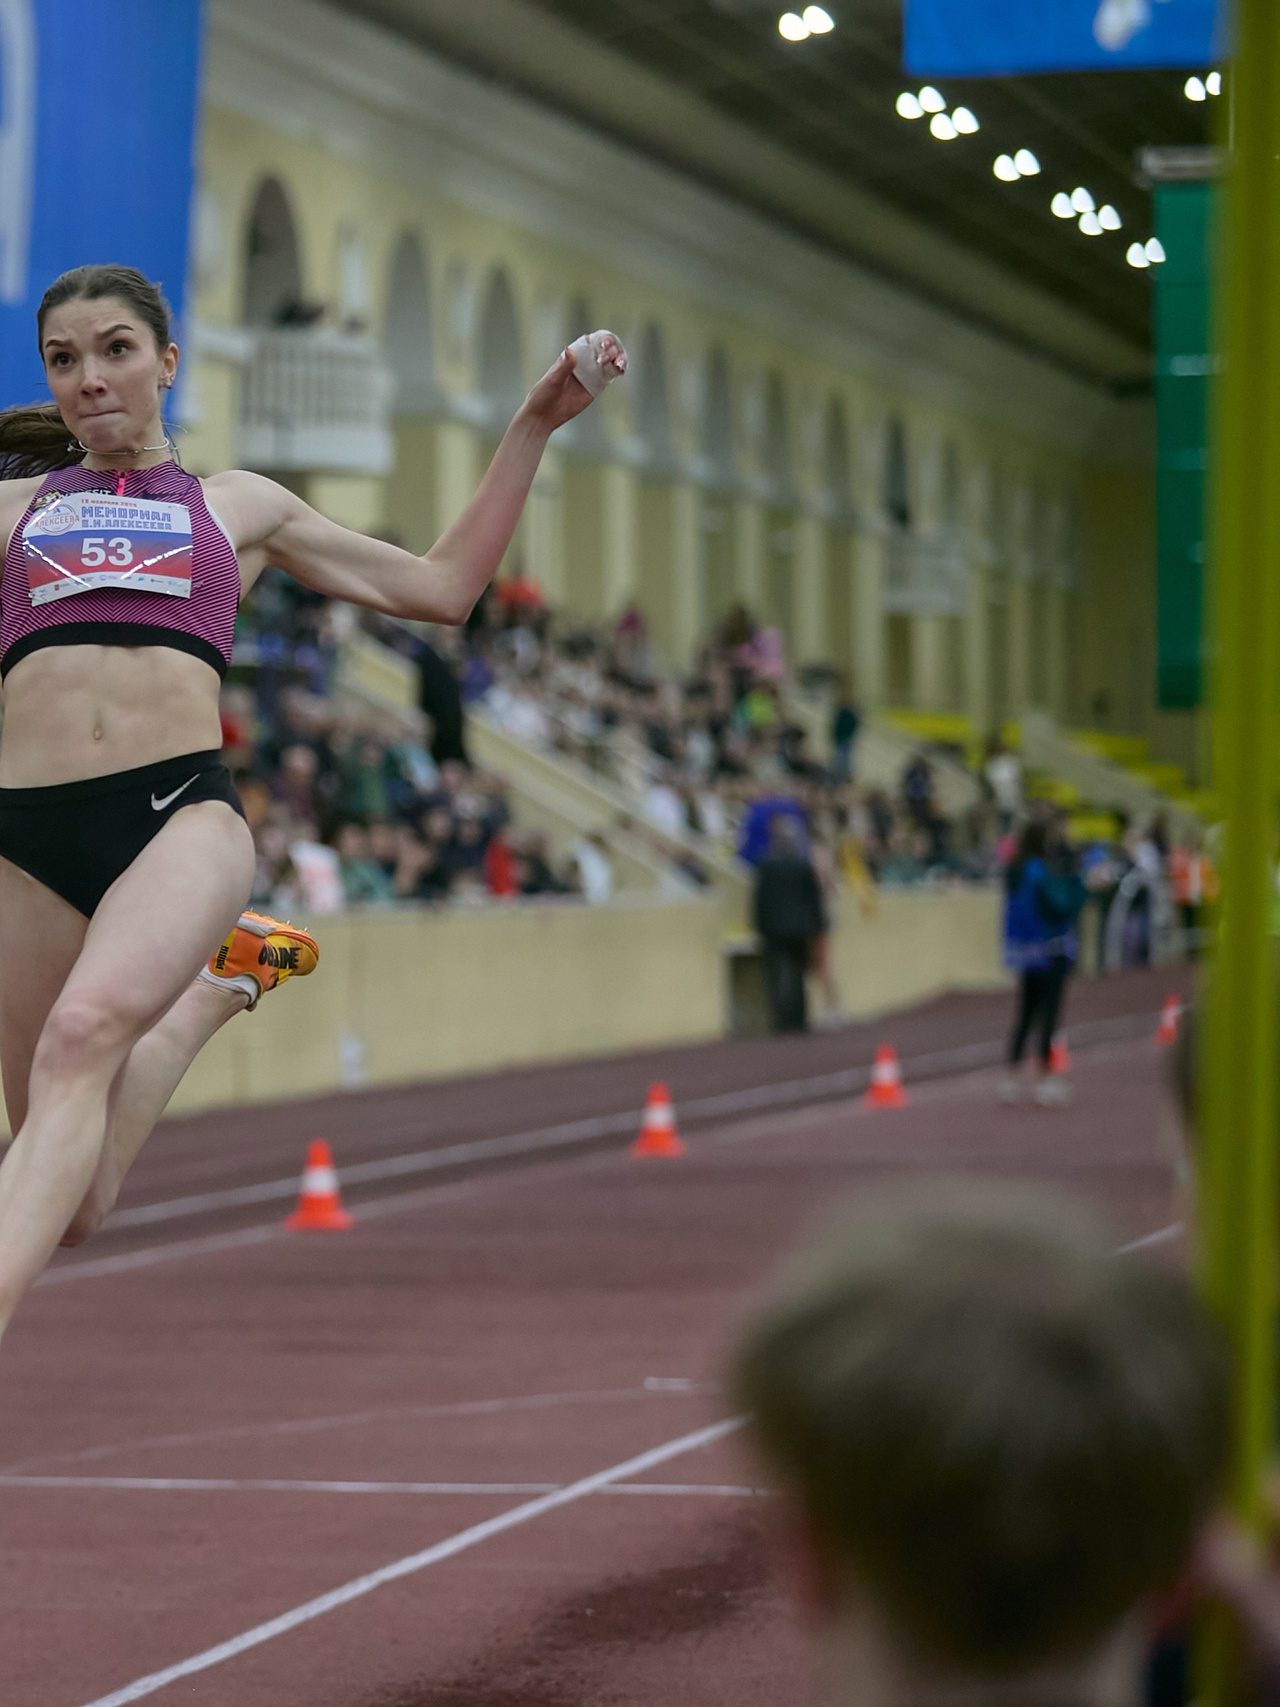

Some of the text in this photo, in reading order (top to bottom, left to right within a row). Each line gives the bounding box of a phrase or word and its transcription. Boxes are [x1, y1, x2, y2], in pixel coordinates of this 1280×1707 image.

[34, 514, 80, 528] АЛЕКСЕЕВА
[81, 506, 172, 522] МЕМОРИАЛ
[80, 537, 134, 567] 53
[215, 945, 230, 970] PUMA
